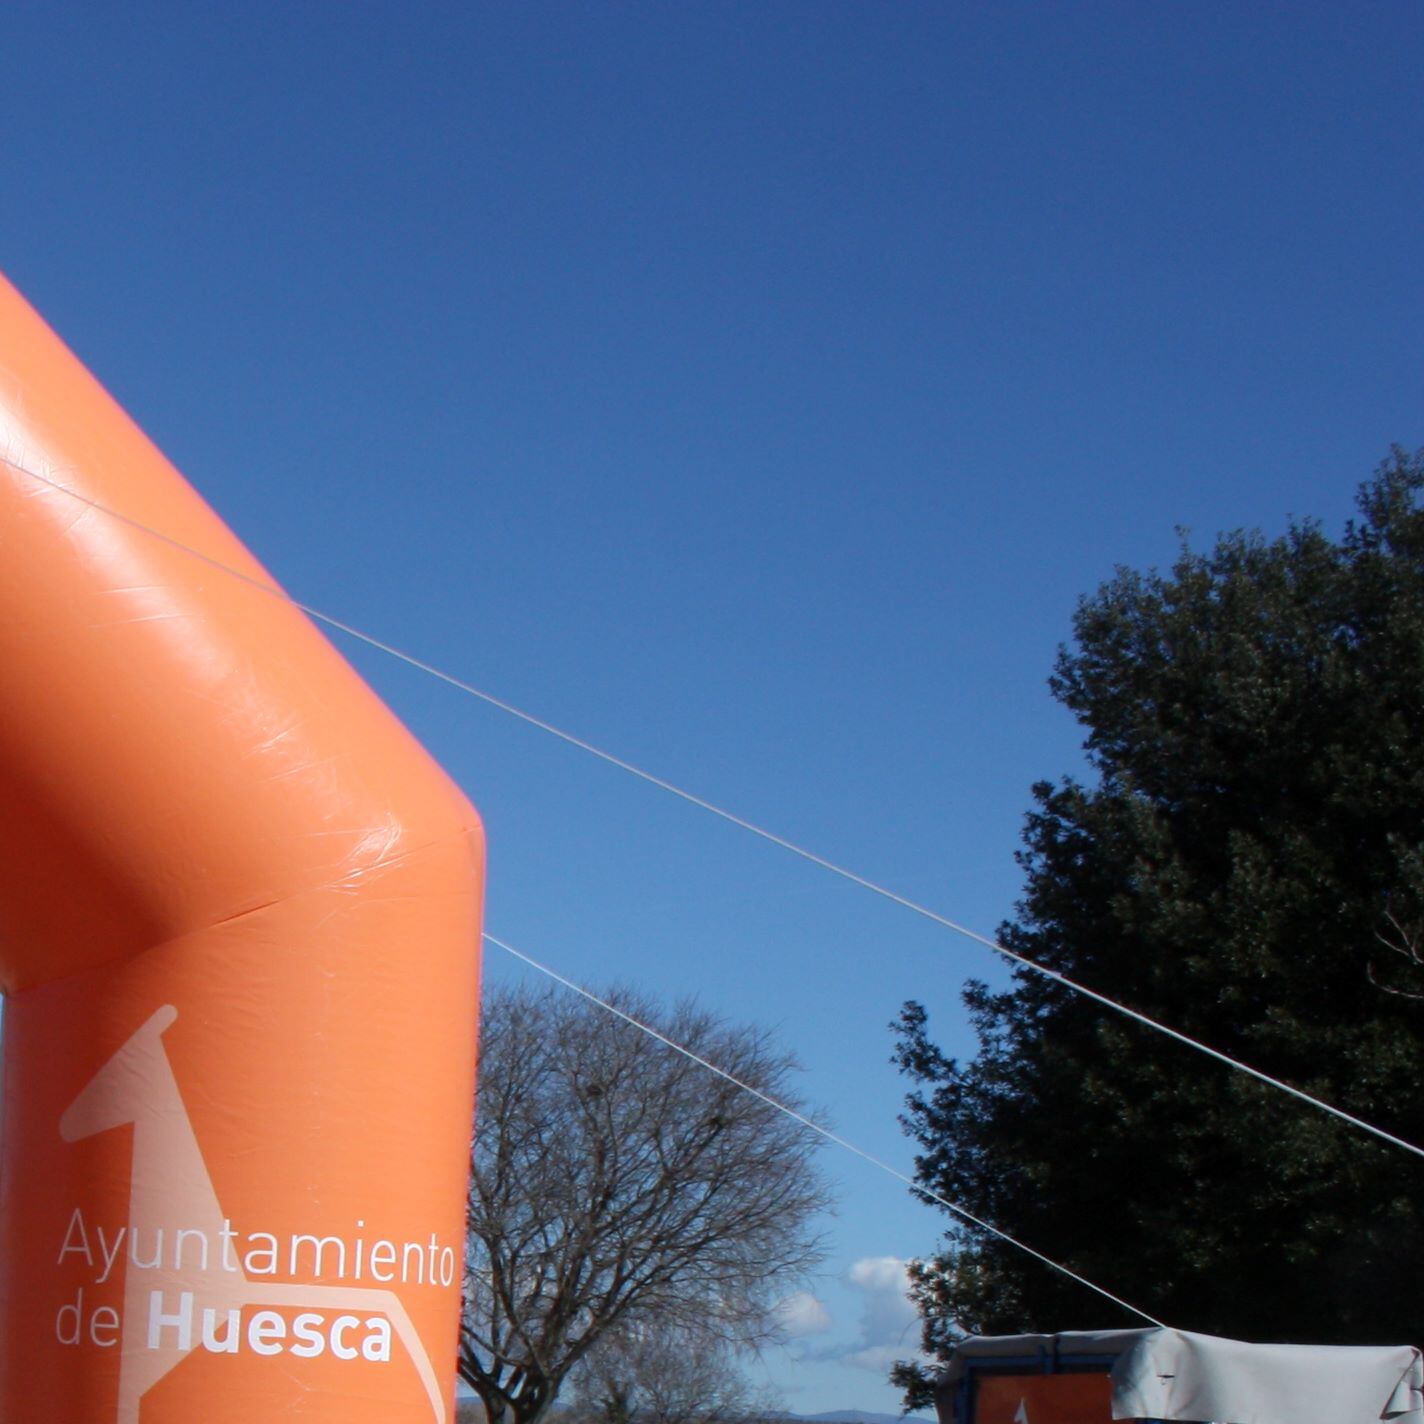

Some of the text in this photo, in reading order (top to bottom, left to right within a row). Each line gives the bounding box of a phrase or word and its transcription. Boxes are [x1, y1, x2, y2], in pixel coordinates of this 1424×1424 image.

[57, 1208, 455, 1288] Ayuntamiento
[56, 1289, 391, 1362] de Huesca
